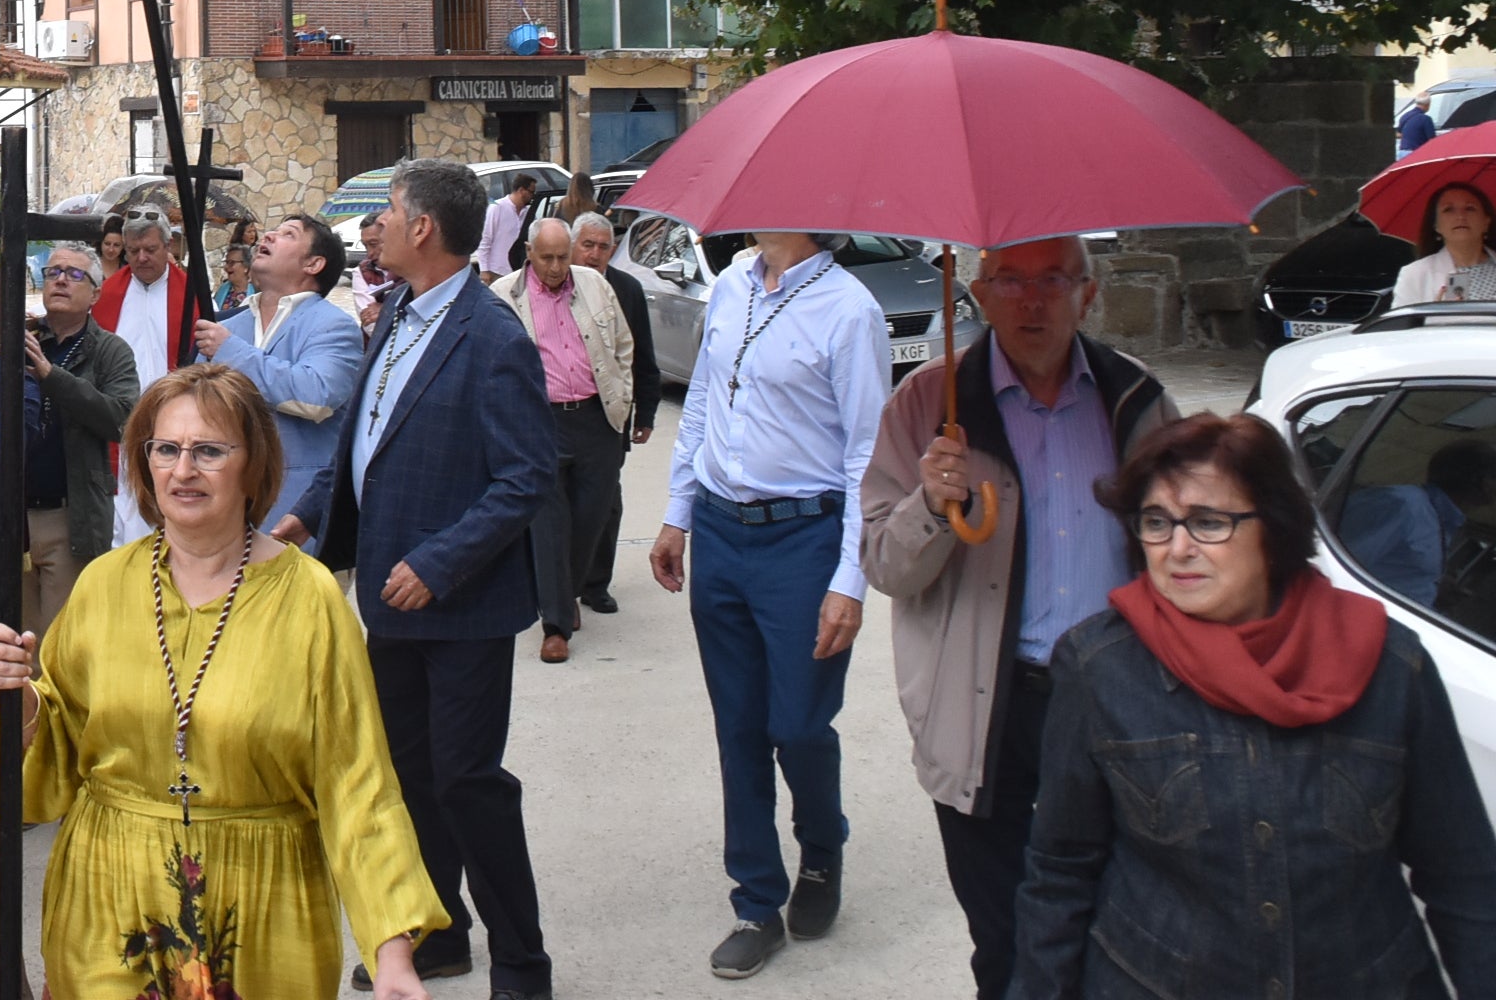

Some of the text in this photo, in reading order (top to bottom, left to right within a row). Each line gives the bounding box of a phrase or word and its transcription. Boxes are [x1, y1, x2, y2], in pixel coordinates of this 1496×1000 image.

[438, 80, 555, 100] CARNICERIA Valencia
[900, 345, 925, 360] KGF
